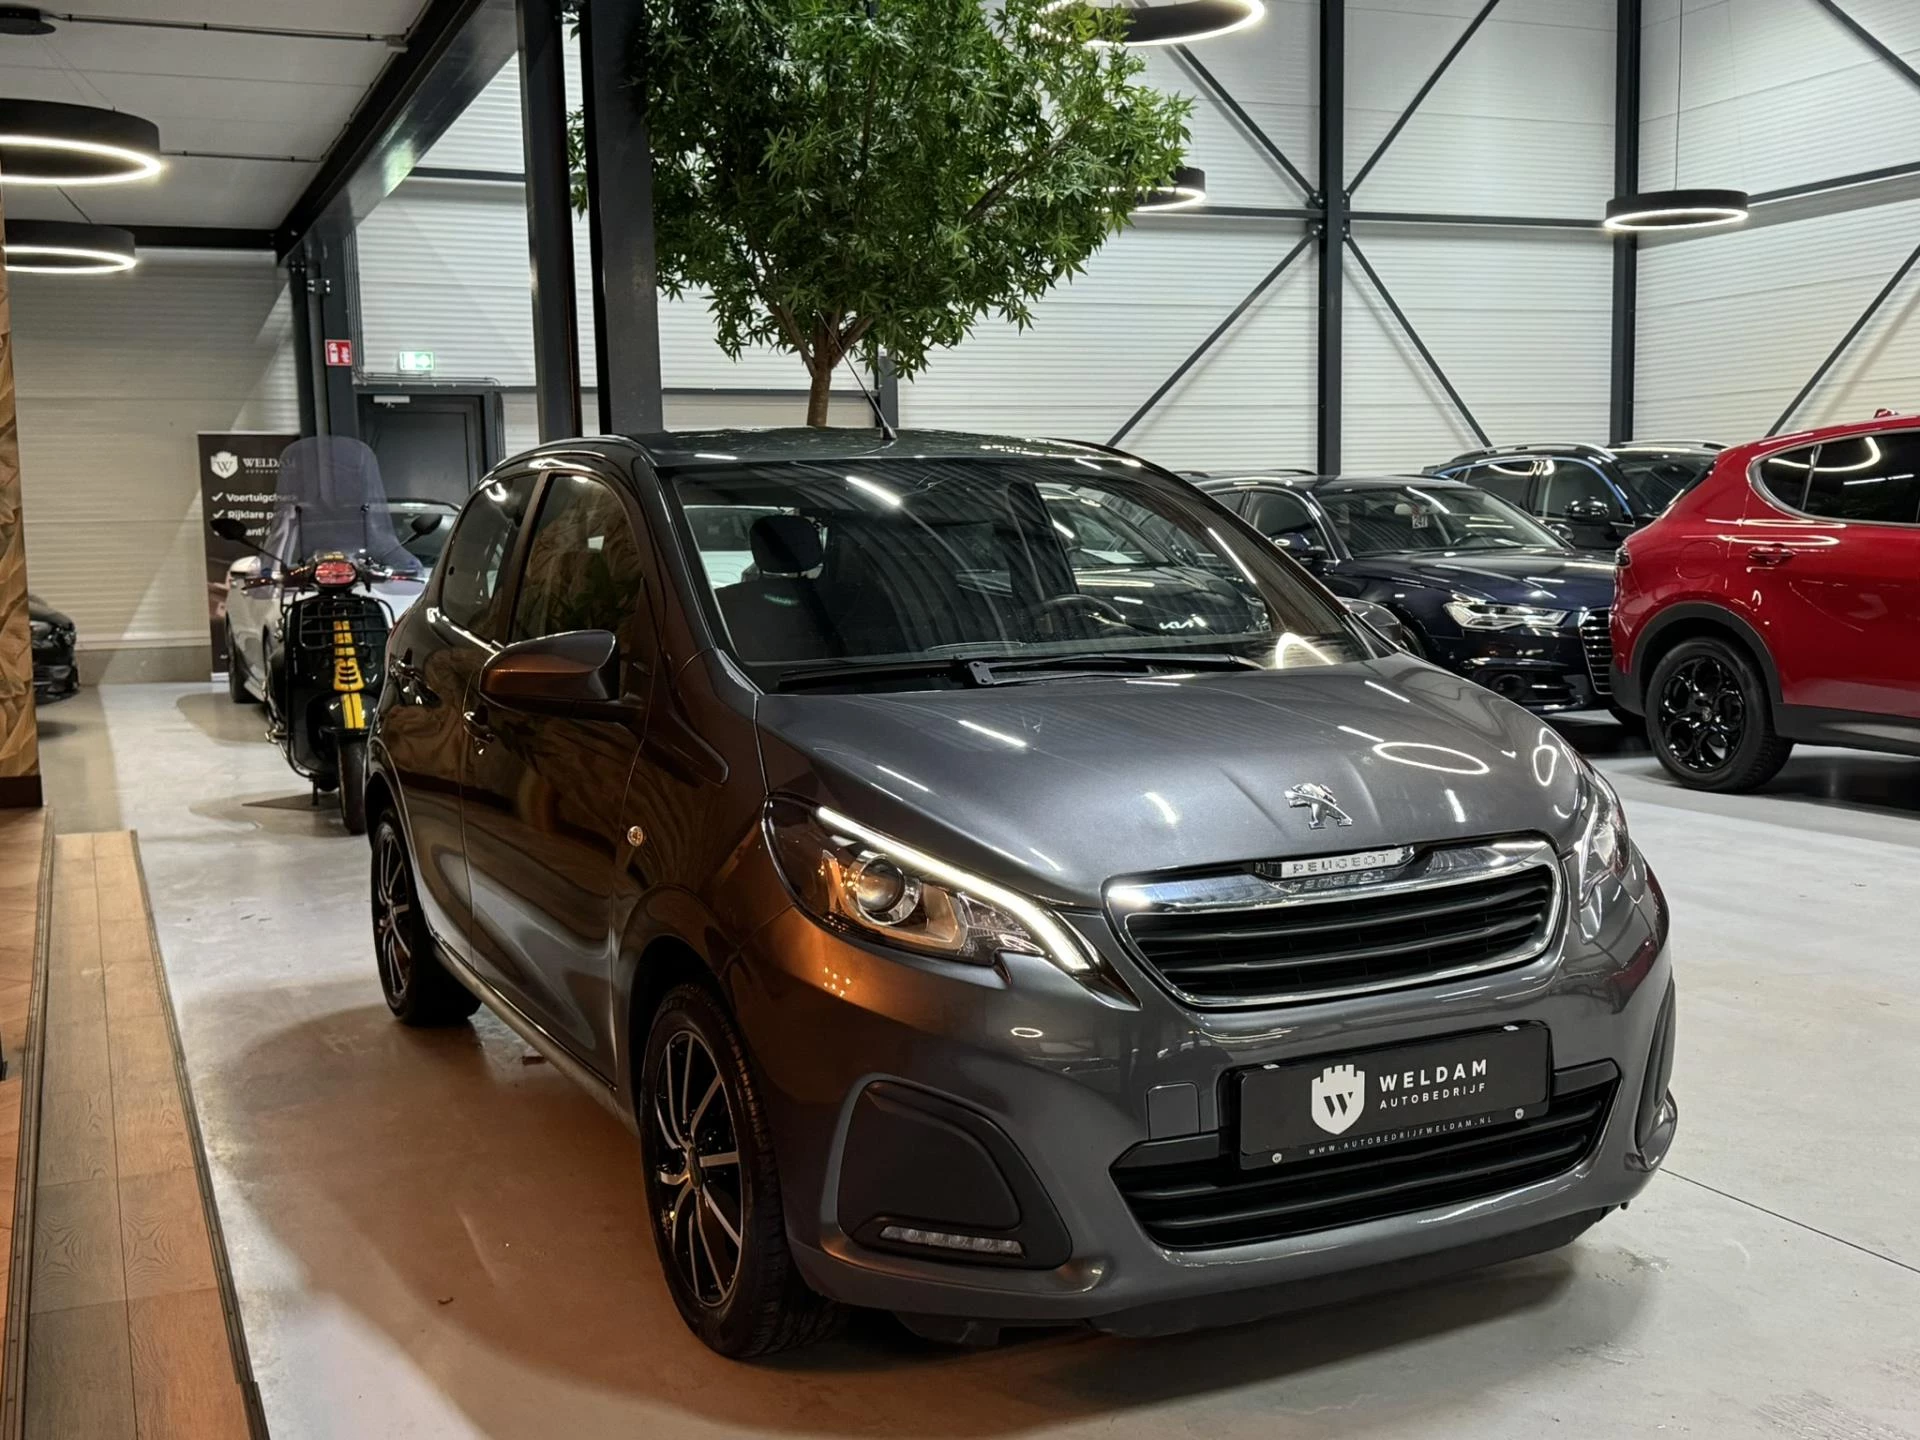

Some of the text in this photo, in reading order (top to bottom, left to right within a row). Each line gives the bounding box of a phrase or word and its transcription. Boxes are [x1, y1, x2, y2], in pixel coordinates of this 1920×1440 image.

[227, 510, 265, 521] Rijklare
[1292, 853, 1389, 874] PEUGEOT
[1379, 1059, 1487, 1092] WELDAM
[1379, 1083, 1486, 1110] AUTOBEDRIJF
[1308, 1117, 1492, 1155] WWW.AUTOBEDRIJFWELDAM.NL
